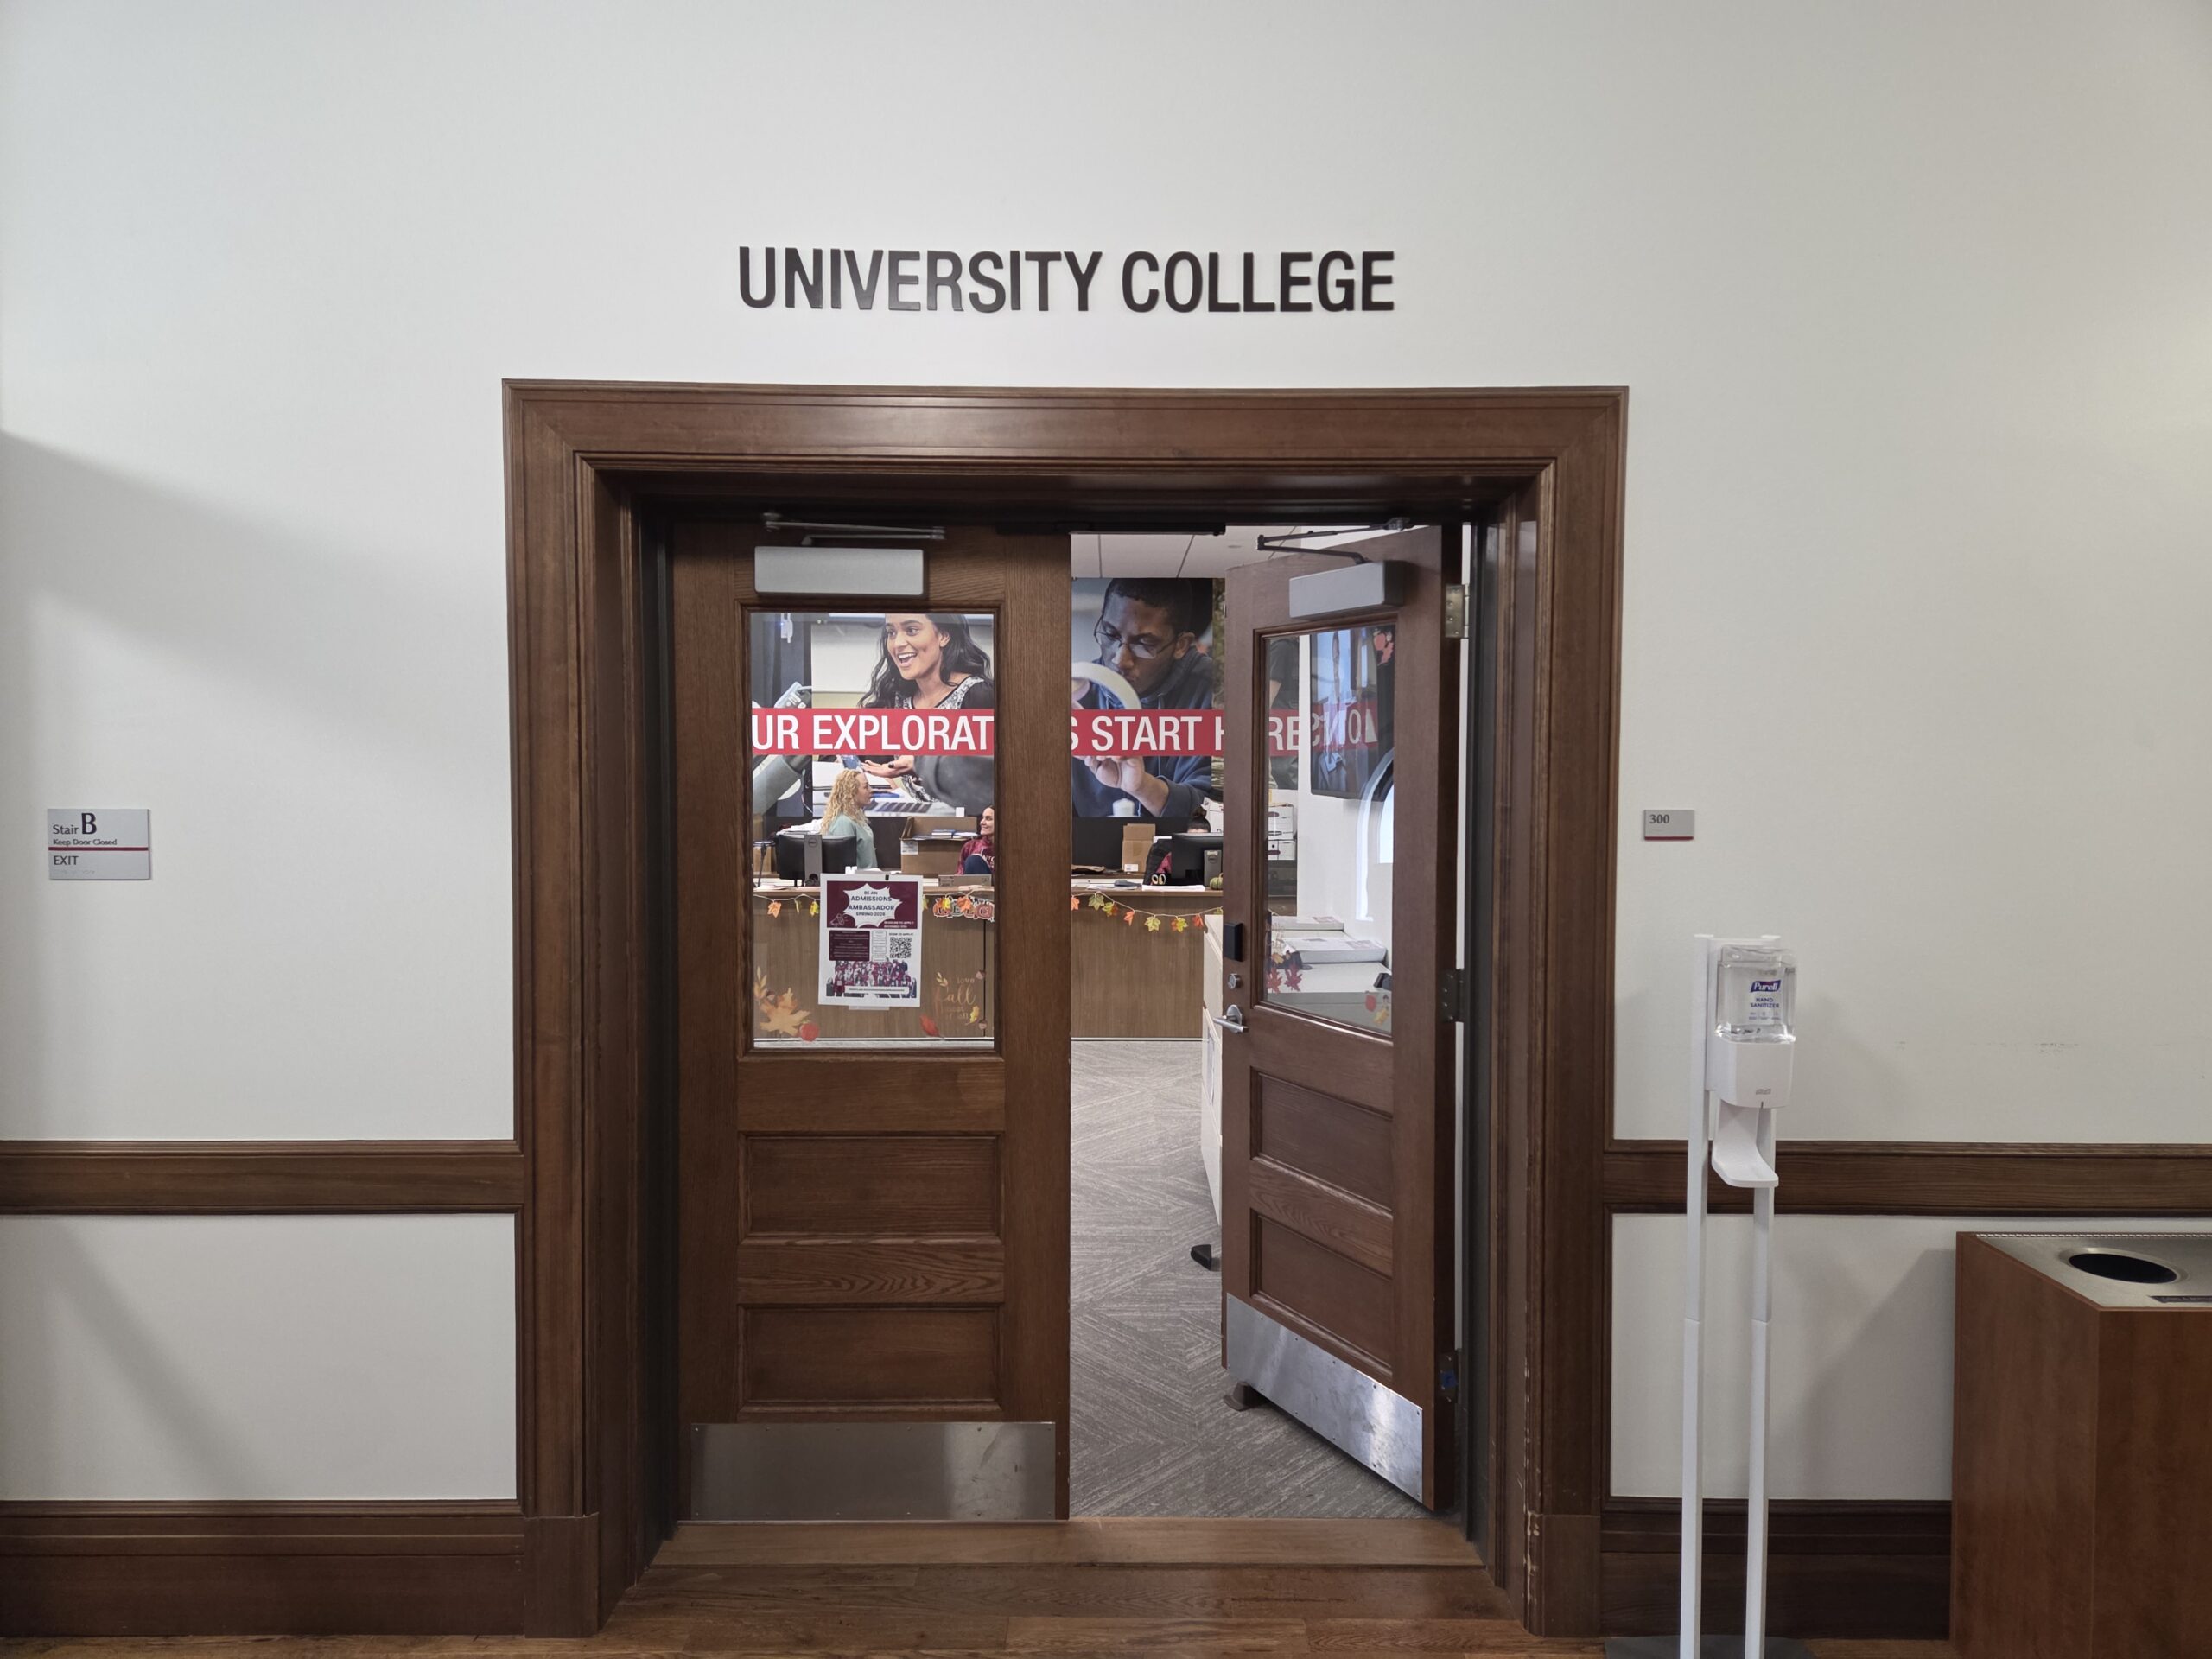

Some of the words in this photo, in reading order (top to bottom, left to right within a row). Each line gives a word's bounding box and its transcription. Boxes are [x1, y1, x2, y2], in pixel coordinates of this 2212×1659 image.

[739, 245, 1103, 314] UNIVERSITY
[1122, 250, 1395, 314] COLLEGE
[752, 715, 799, 750] UR
[1091, 715, 1203, 752] START
[53, 823, 79, 835] Stair
[81, 812, 97, 835] B
[1649, 814, 1670, 824] 300
[53, 838, 71, 847] Keep
[54, 855, 79, 866] EXIT
